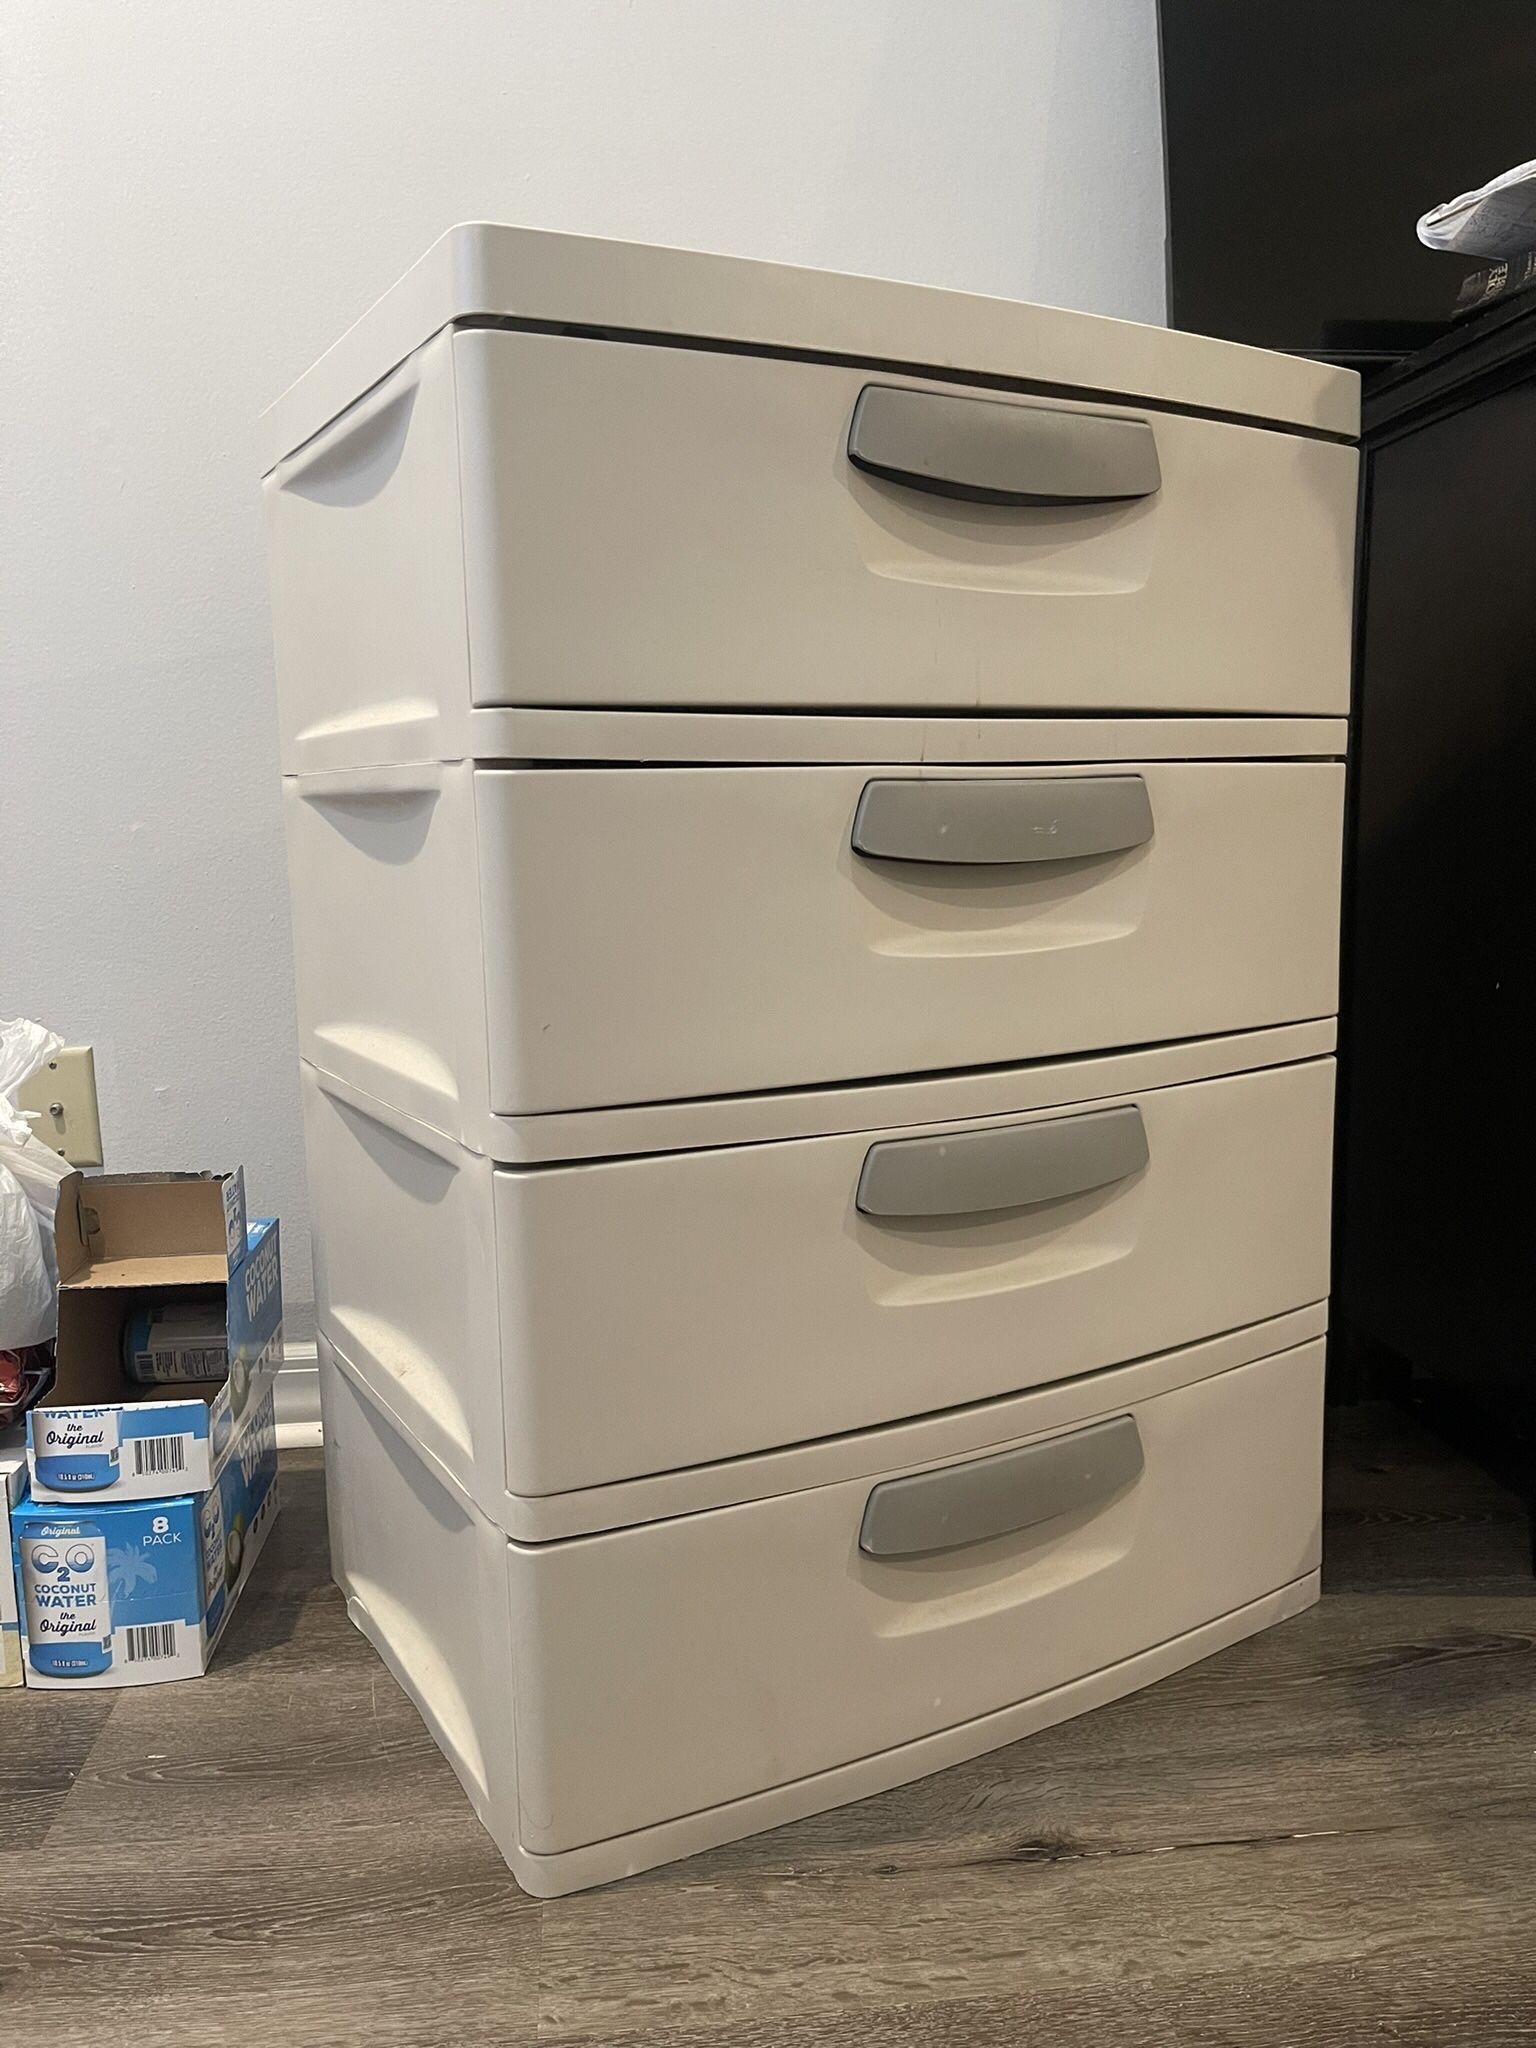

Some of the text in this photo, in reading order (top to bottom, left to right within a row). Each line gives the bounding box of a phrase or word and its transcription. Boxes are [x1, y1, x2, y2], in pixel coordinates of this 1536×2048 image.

[245, 1231, 278, 1293] COCONUT
[246, 1255, 279, 1322] WATER
[66, 1423, 83, 1431] the
[46, 1430, 104, 1449] Original
[40, 1525, 81, 1538] Original
[152, 1516, 169, 1534] 8
[142, 1532, 182, 1547] PACK
[34, 1583, 96, 1594] COCONUT
[36, 1594, 97, 1608] WATER
[60, 1611, 76, 1620] the
[40, 1619, 97, 1637] Original
